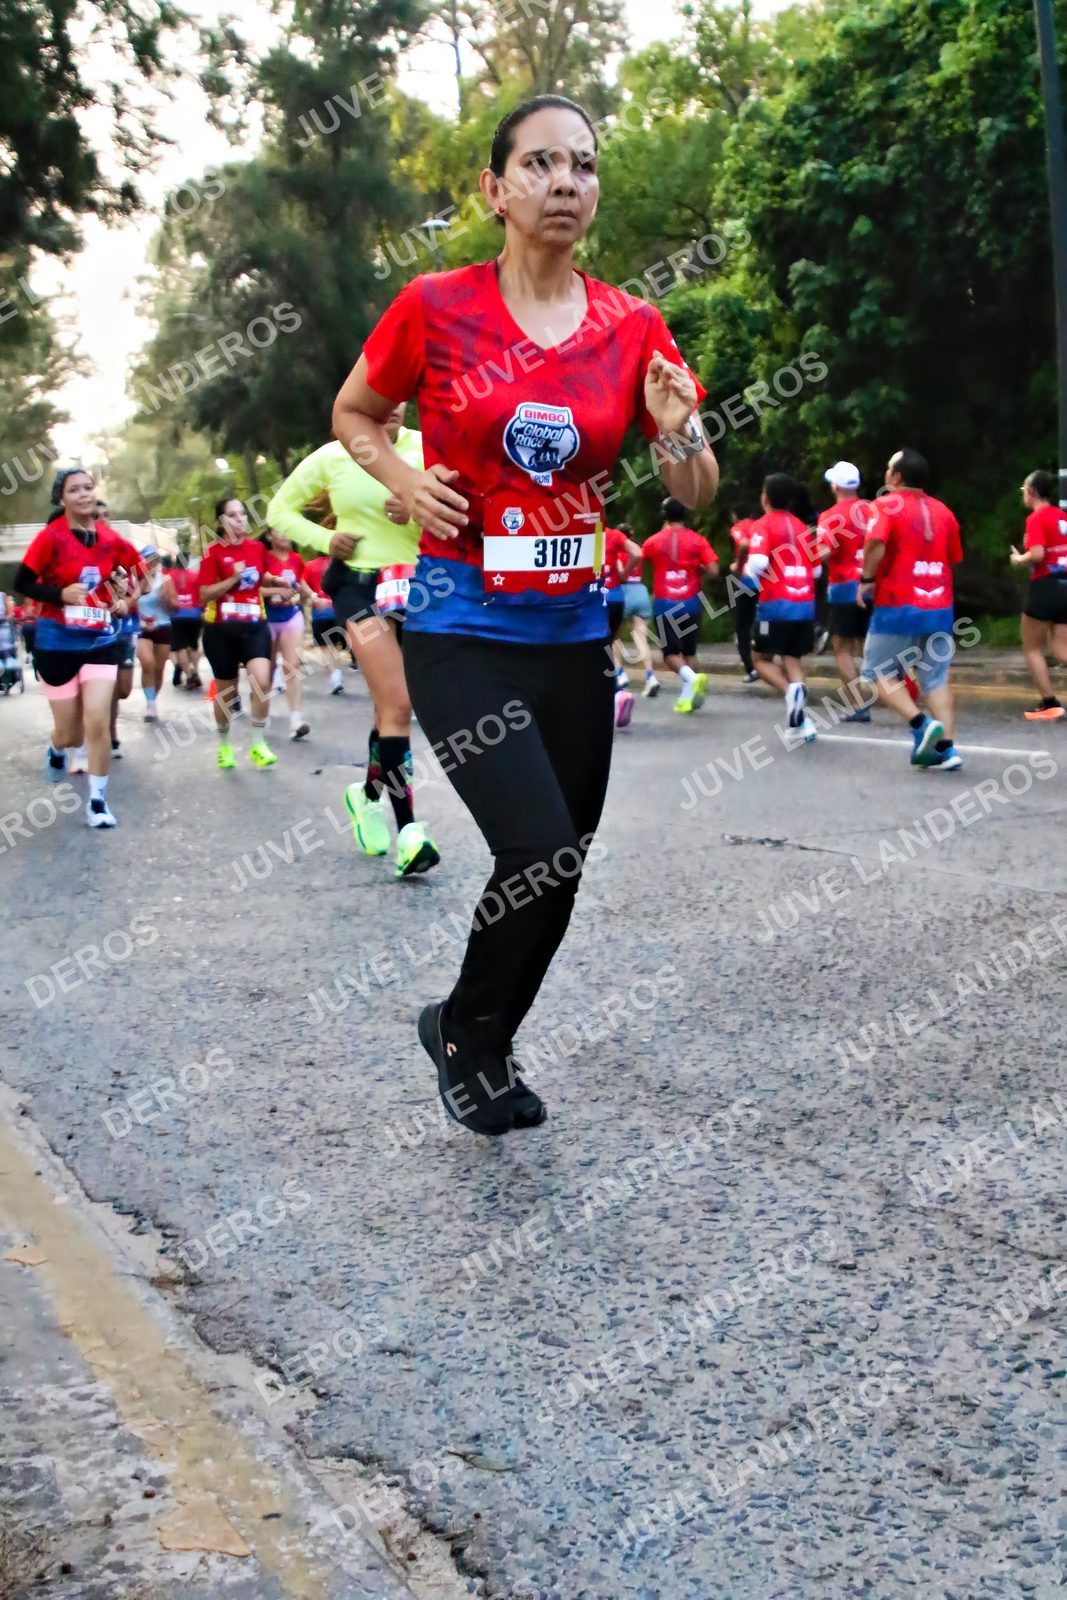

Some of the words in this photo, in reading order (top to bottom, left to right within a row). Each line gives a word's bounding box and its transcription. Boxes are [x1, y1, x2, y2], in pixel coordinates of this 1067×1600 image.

[524, 409, 565, 423] BIMBO
[523, 423, 563, 441] Global
[534, 537, 583, 568] 3187
[548, 573, 569, 584] 20-26
